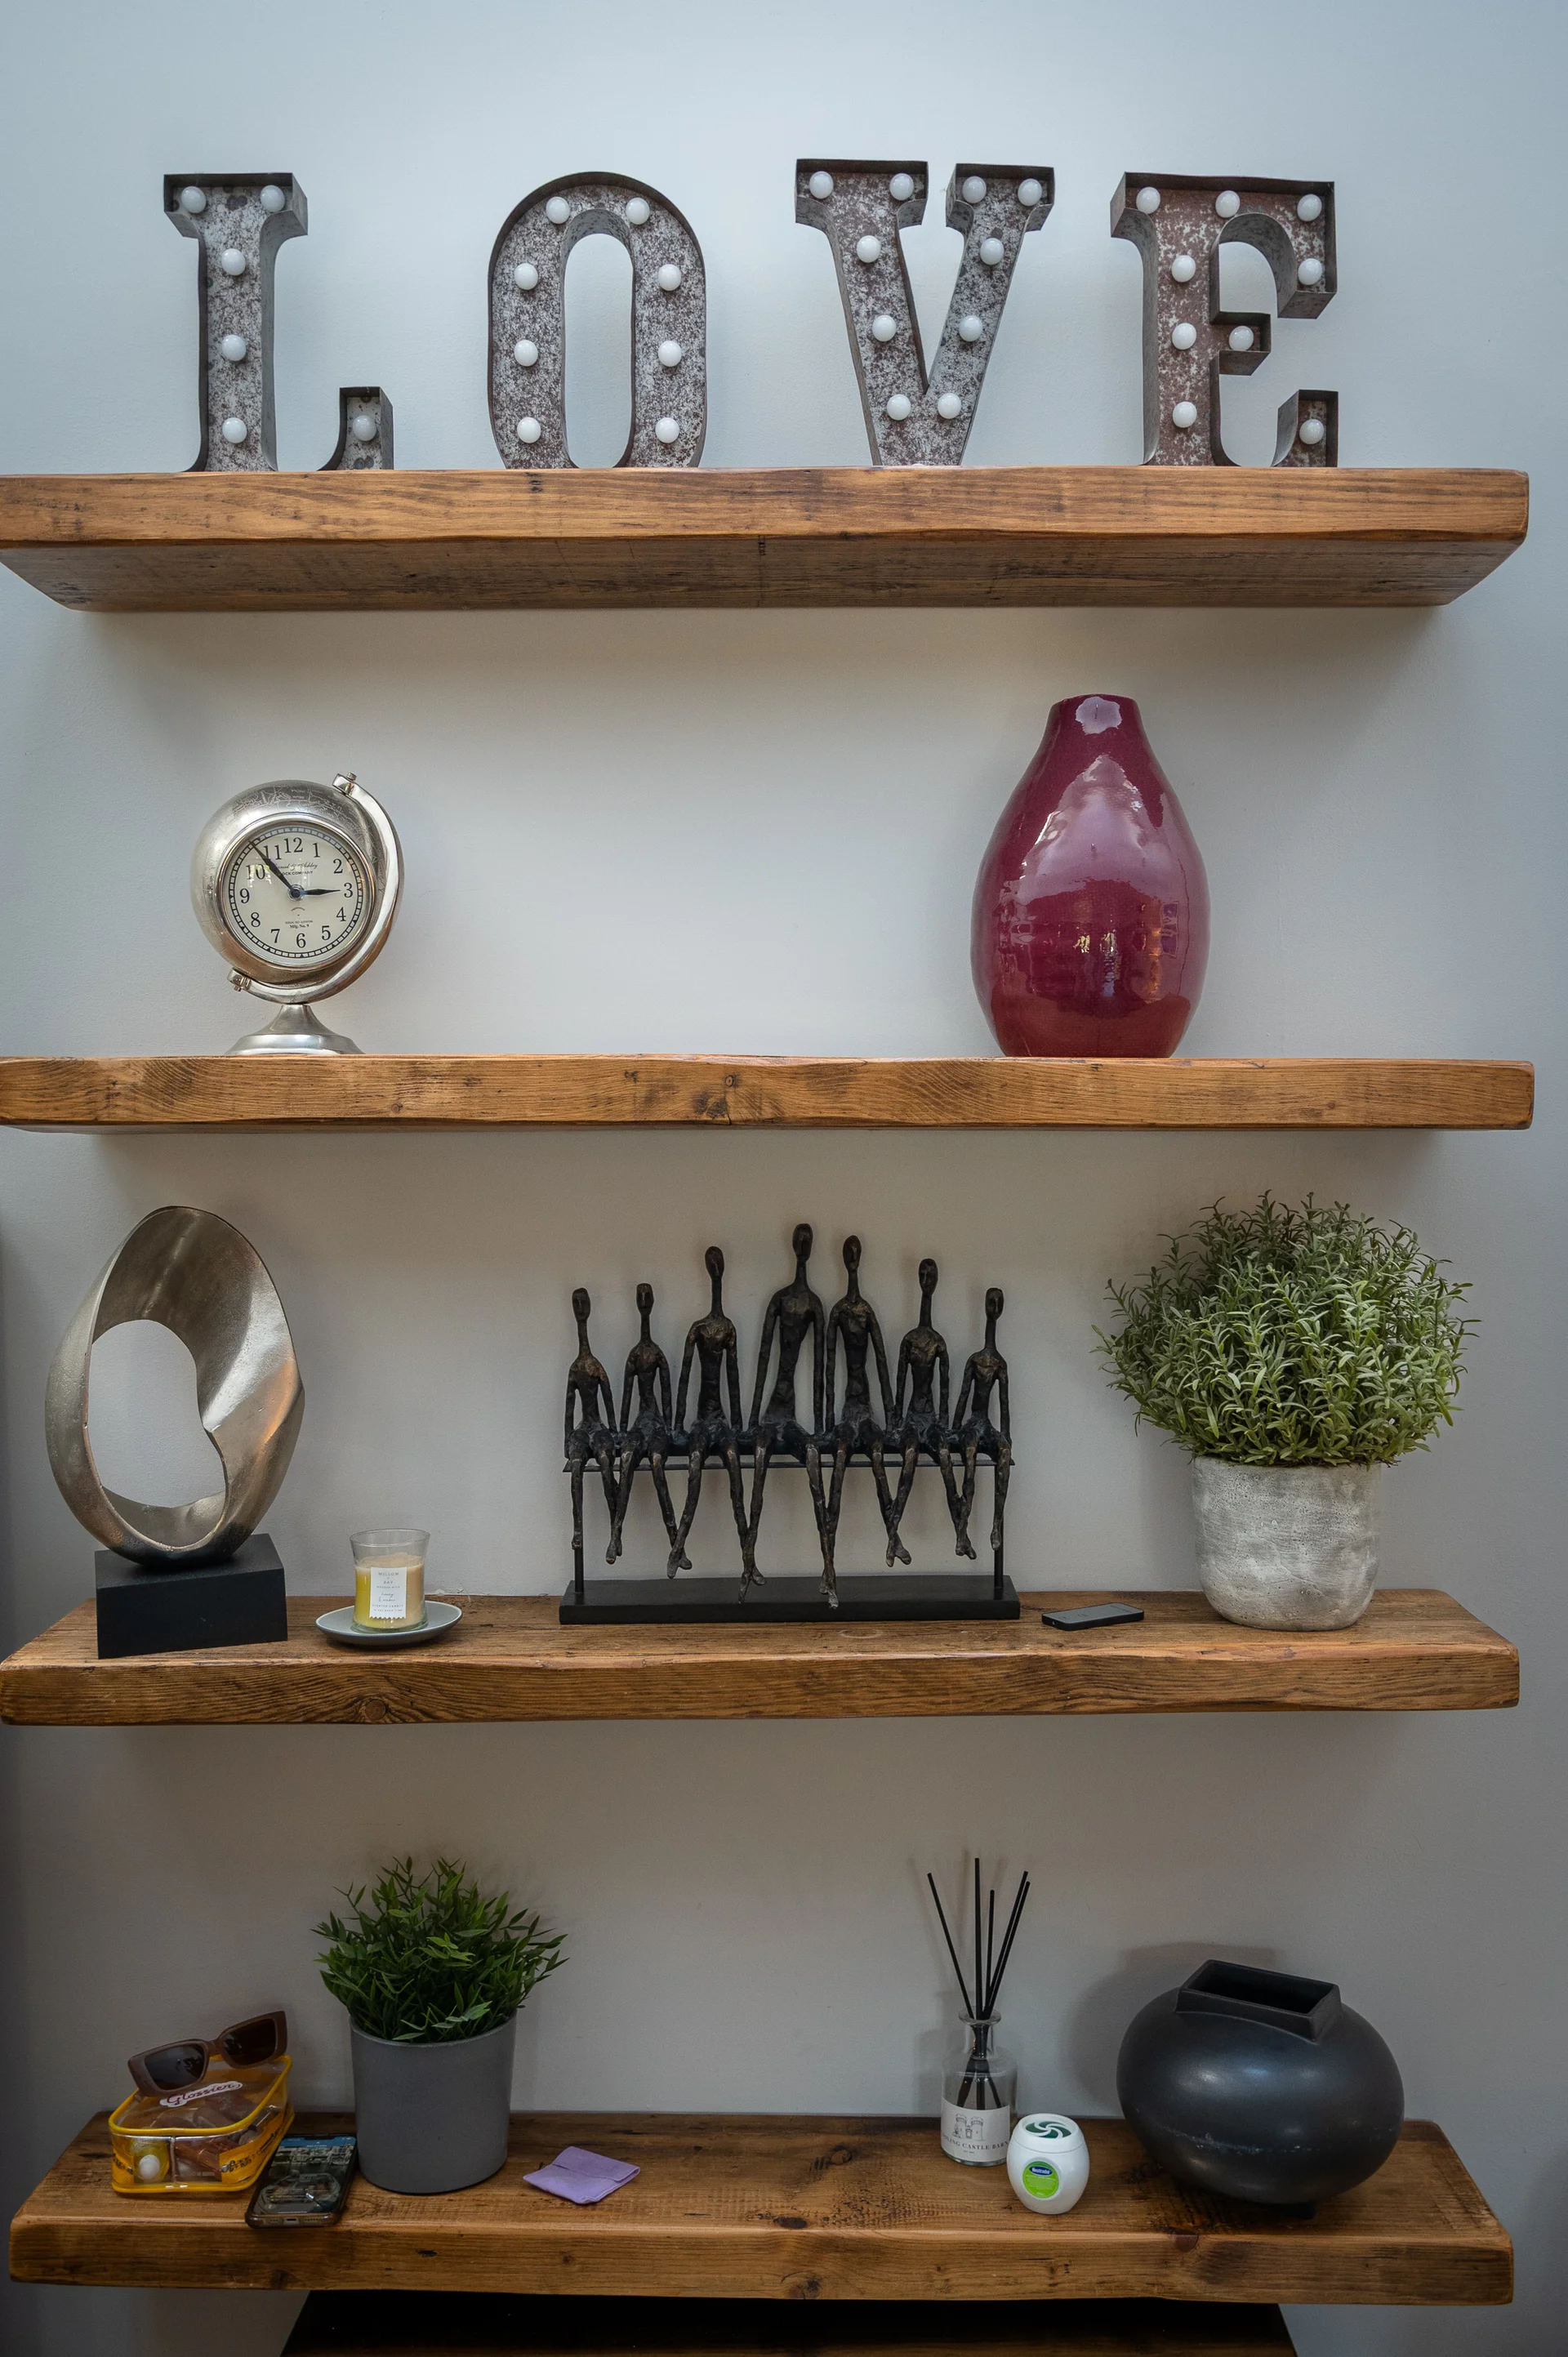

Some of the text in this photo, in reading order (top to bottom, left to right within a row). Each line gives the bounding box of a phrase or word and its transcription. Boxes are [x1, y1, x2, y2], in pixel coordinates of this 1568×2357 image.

[163, 158, 1338, 471] LOVE
[264, 844, 282, 860] 11
[283, 837, 304, 853] 12
[313, 842, 321, 858] 1
[246, 863, 265, 880] 10
[332, 858, 343, 874] 2
[239, 888, 250, 904] 9
[343, 882, 354, 898] 3
[250, 911, 261, 928] 8
[336, 907, 346, 922] 4
[270, 929, 281, 943] 7
[296, 933, 306, 948] 6
[321, 925, 332, 941] 5
